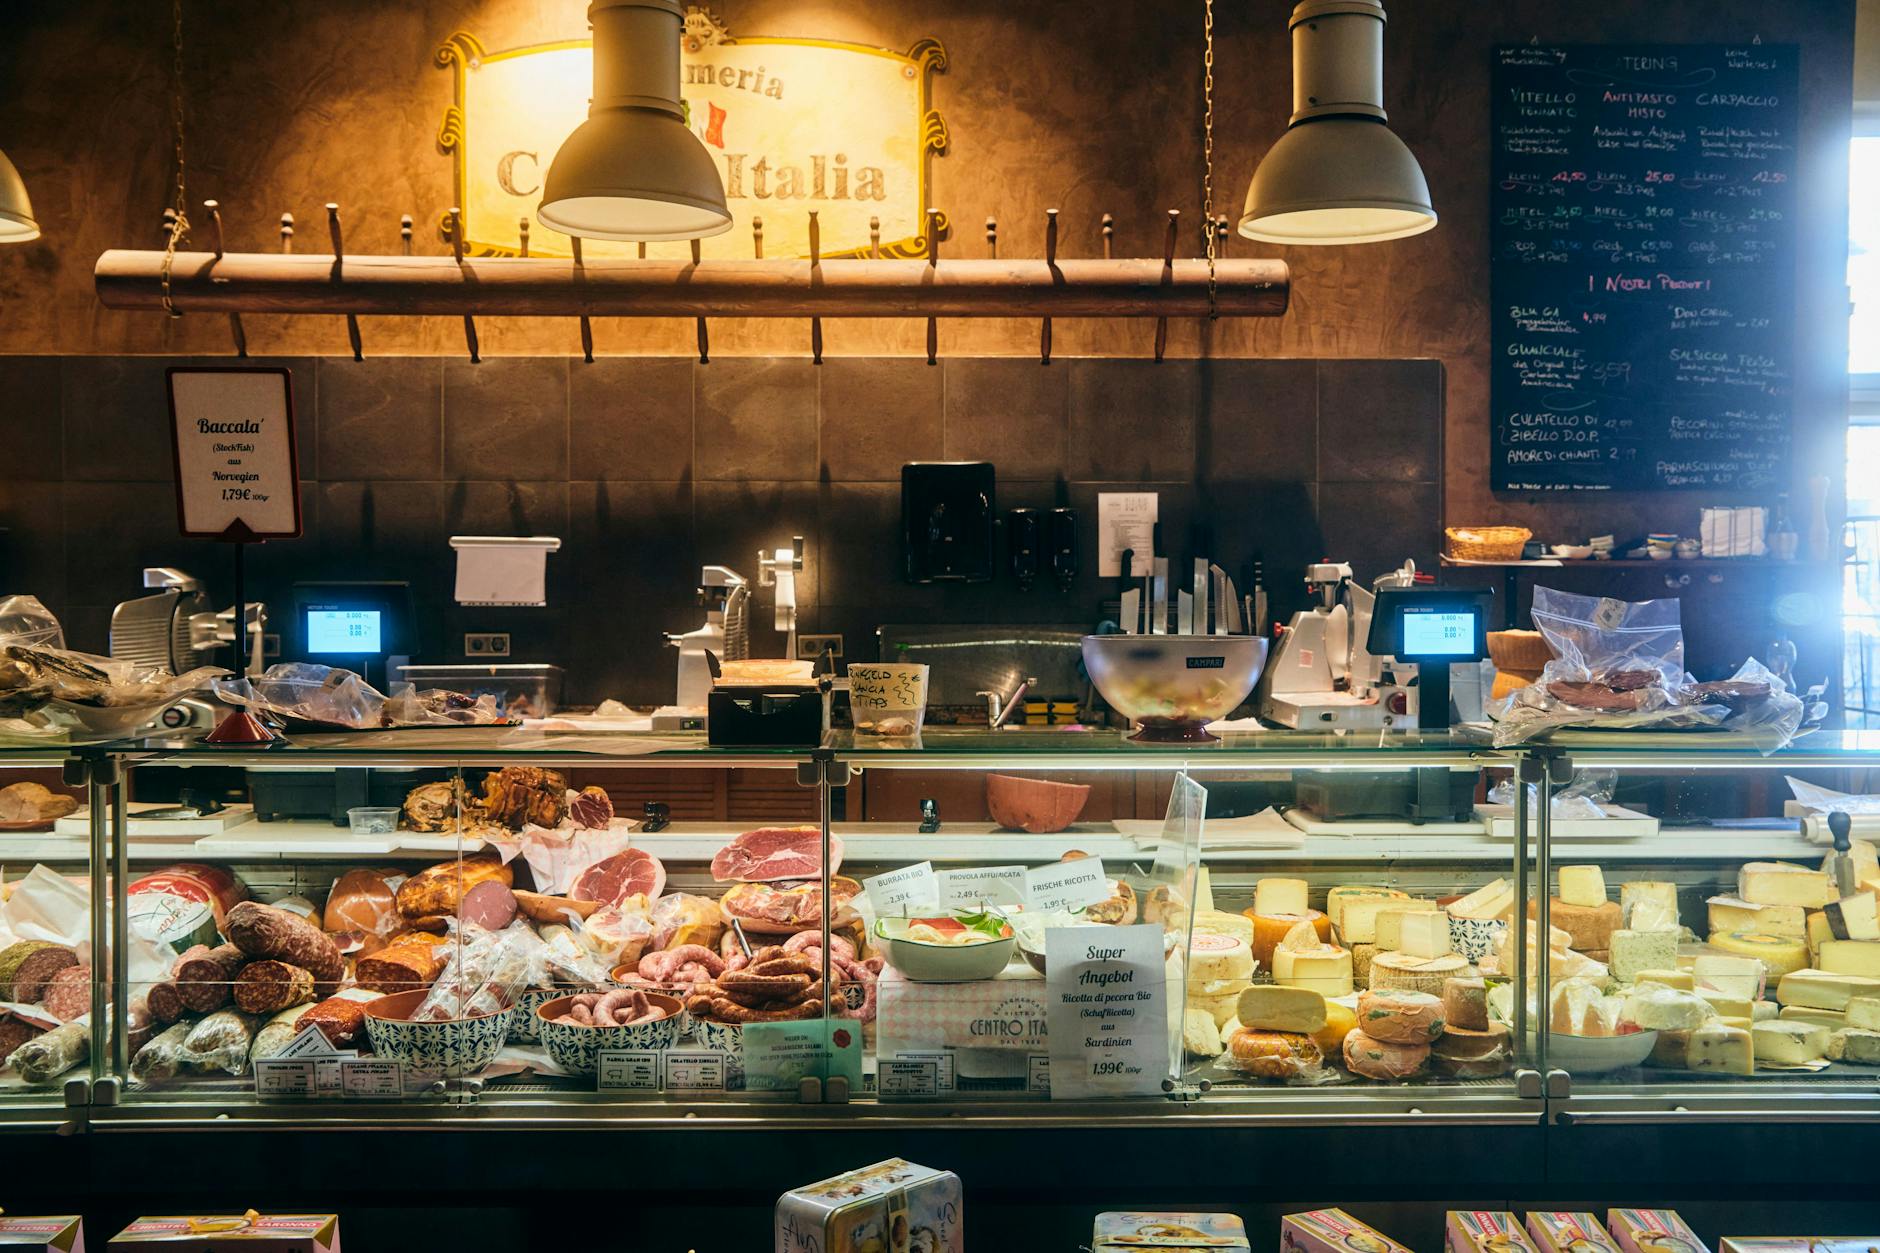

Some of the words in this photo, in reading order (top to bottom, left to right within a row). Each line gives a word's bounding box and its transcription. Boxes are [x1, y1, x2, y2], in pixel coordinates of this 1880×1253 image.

[682, 62, 784, 100] meria
[1510, 87, 1576, 103] VITELLO
[1695, 92, 1779, 107] CARPACCIO
[1627, 106, 1666, 119] MISTO
[724, 152, 888, 202] Italia
[196, 417, 265, 434] Baccala'
[1510, 413, 1579, 426] CULATELLO
[1510, 430, 1559, 442] ZIBELLO
[227, 458, 242, 466] aus
[212, 471, 260, 484] Norvegien
[1187, 657, 1224, 668] CAMPARI
[877, 872, 911, 888] BURRATA
[910, 869, 925, 880] BIO
[949, 873, 978, 881] PROVOLA
[1032, 880, 1064, 893] FRISCHE
[1064, 873, 1098, 888] RICOTTA
[957, 890, 973, 899] 2,49
[1086, 945, 1126, 962] Super
[1078, 969, 1134, 987] Angebot
[1062, 993, 1093, 1003] Ricotta
[1094, 993, 1104, 1003] di
[1104, 993, 1134, 1005] pecora
[1136, 991, 1152, 1001] Bio
[1080, 1008, 1135, 1020] (SchafRicotta)
[970, 1019, 1023, 1036] CENTRO
[1100, 1023, 1115, 1031] aus
[1084, 1037, 1132, 1048] Sardinien
